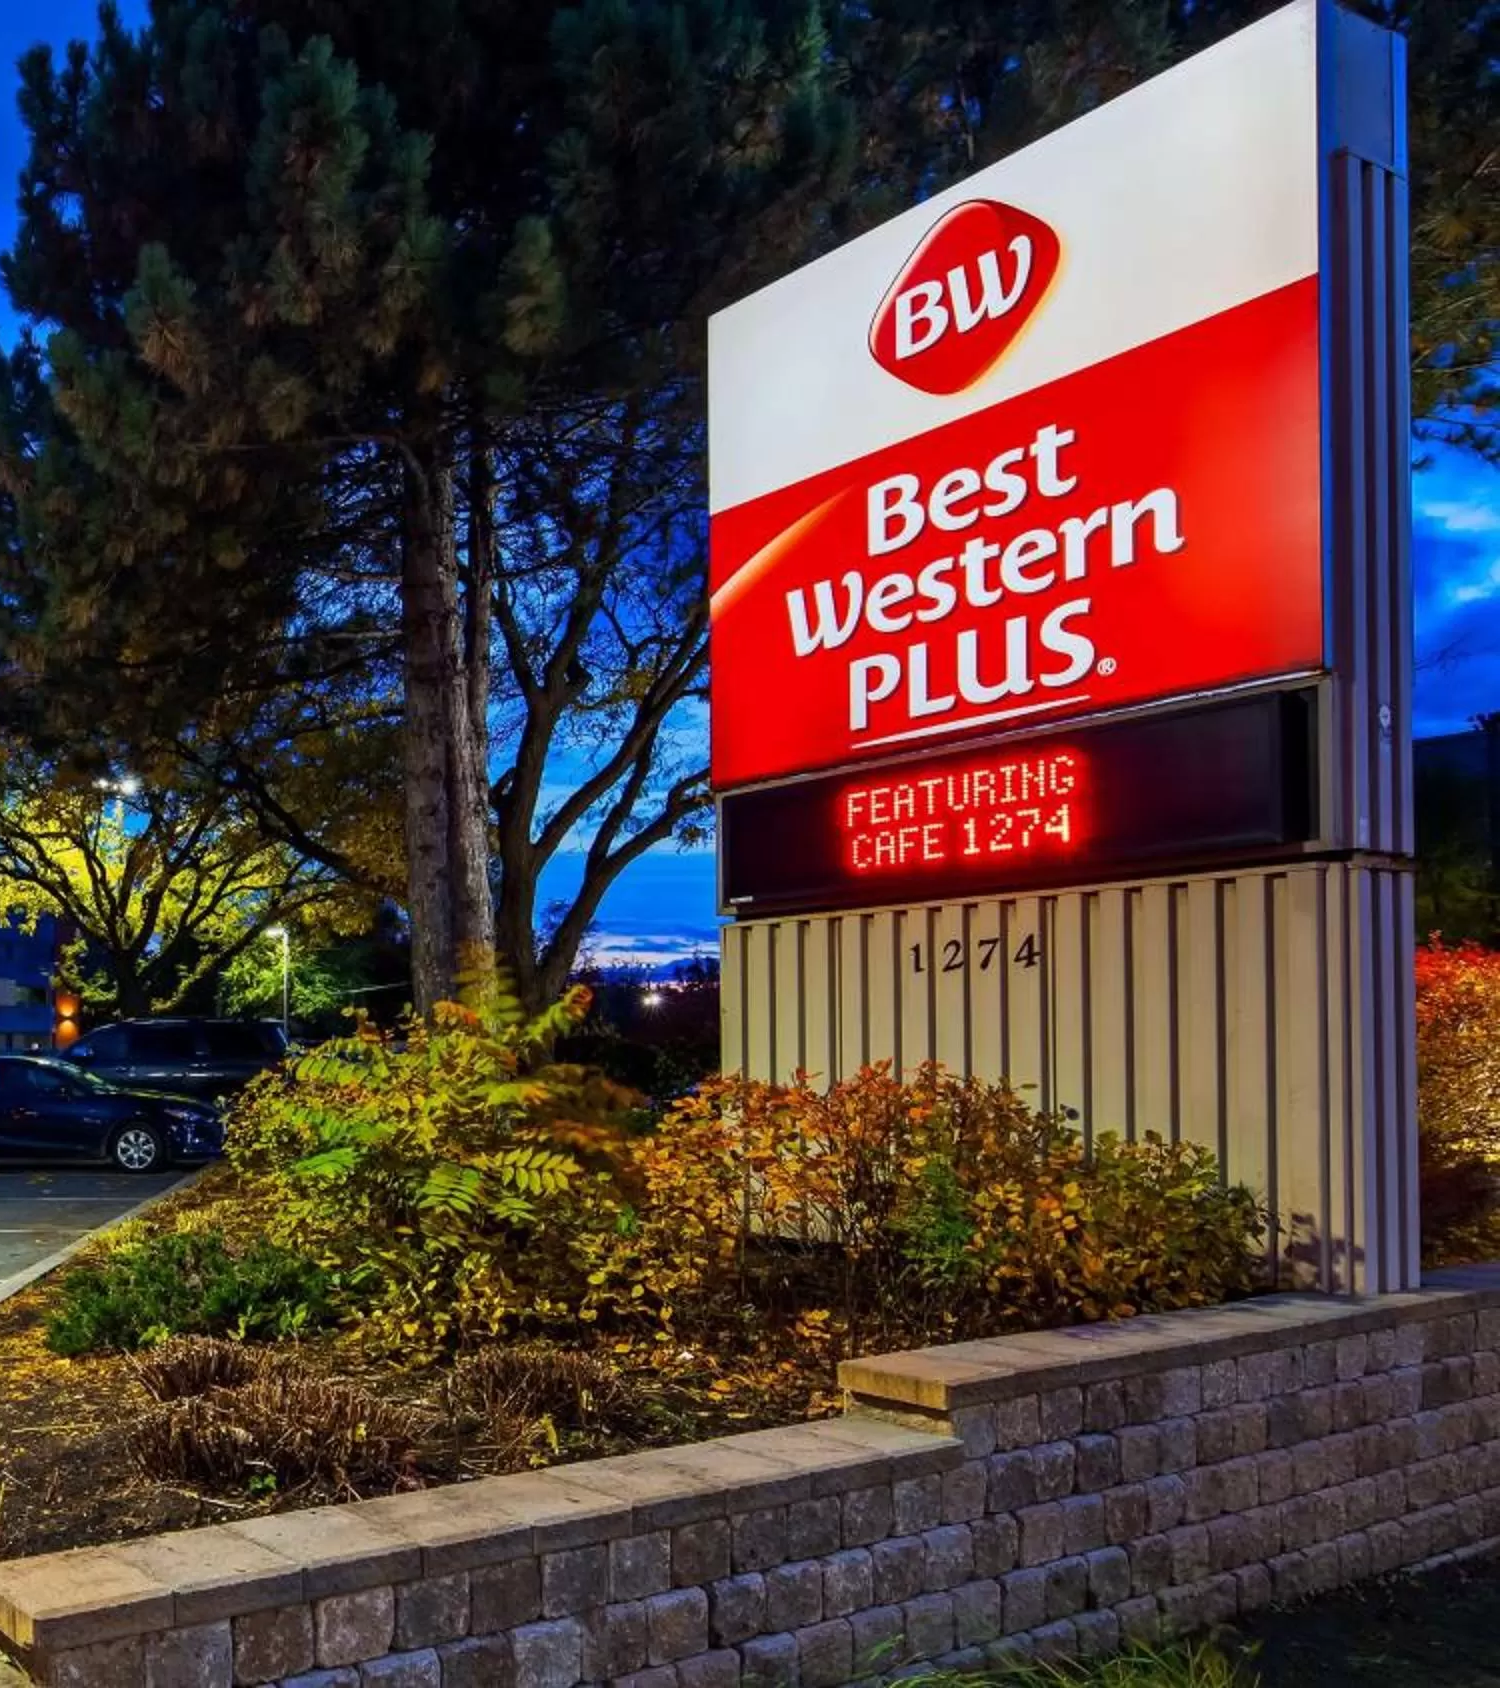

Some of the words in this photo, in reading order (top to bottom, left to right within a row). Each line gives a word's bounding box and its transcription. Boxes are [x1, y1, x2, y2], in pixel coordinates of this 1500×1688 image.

[895, 235, 1033, 360] BW
[866, 424, 1078, 557] Best
[785, 487, 1185, 658] Western
[846, 755, 1076, 828] FEATURING
[851, 823, 944, 870] CAFE
[962, 803, 1072, 857] 1274
[910, 933, 1042, 974] 1274
